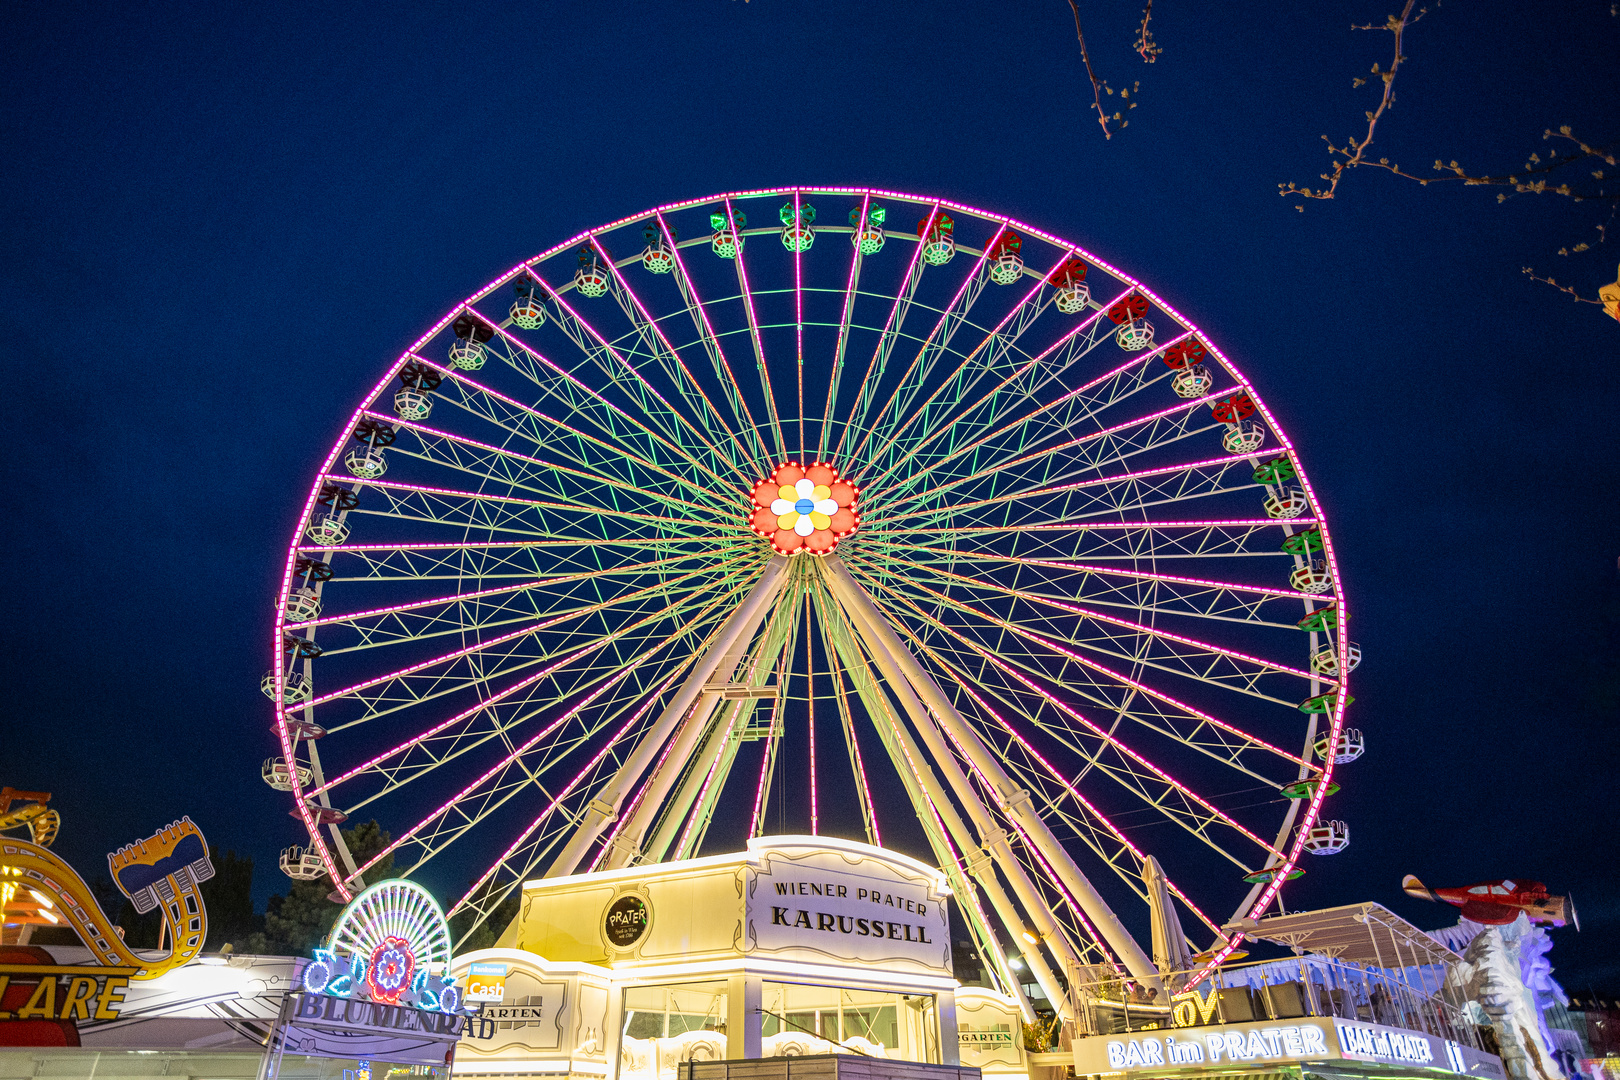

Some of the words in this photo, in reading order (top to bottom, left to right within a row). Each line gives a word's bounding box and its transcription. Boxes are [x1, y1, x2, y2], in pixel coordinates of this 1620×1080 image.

[774, 882, 847, 898] WIENER
[857, 888, 927, 917] PRATER
[609, 908, 646, 926] PRATER
[771, 906, 932, 944] KARUSSELL
[470, 982, 504, 995] Cash
[297, 991, 495, 1040] BLUMENRAD
[475, 1008, 542, 1018] ARTEN
[958, 1033, 1012, 1042] GARTEN
[1107, 1040, 1164, 1068] BAR
[1166, 1035, 1203, 1063] im
[1206, 1025, 1328, 1060] PRATER
